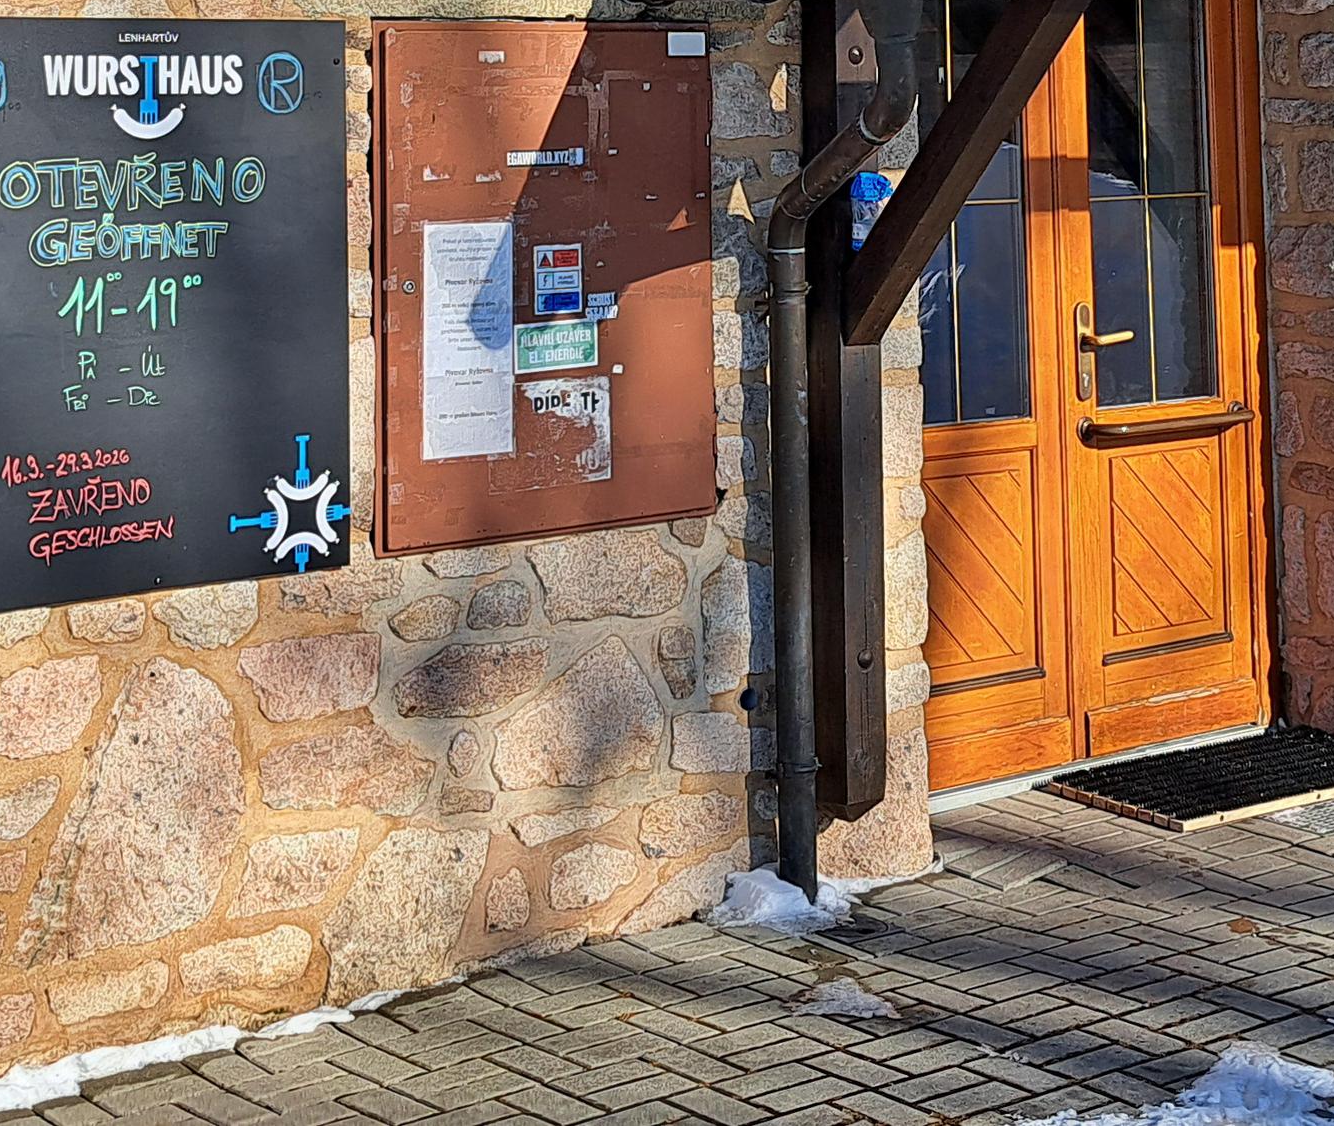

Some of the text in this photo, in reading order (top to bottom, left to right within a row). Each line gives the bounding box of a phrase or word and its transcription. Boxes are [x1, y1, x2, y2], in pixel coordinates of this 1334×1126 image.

[118, 31, 180, 43] LENHARTŮV
[43, 54, 243, 97] WURSTHAUS
[28, 213, 228, 267] GEÖFFNET
[28, 476, 152, 524] ZAVŘENO
[28, 515, 174, 567] GESCHLOSSEN
